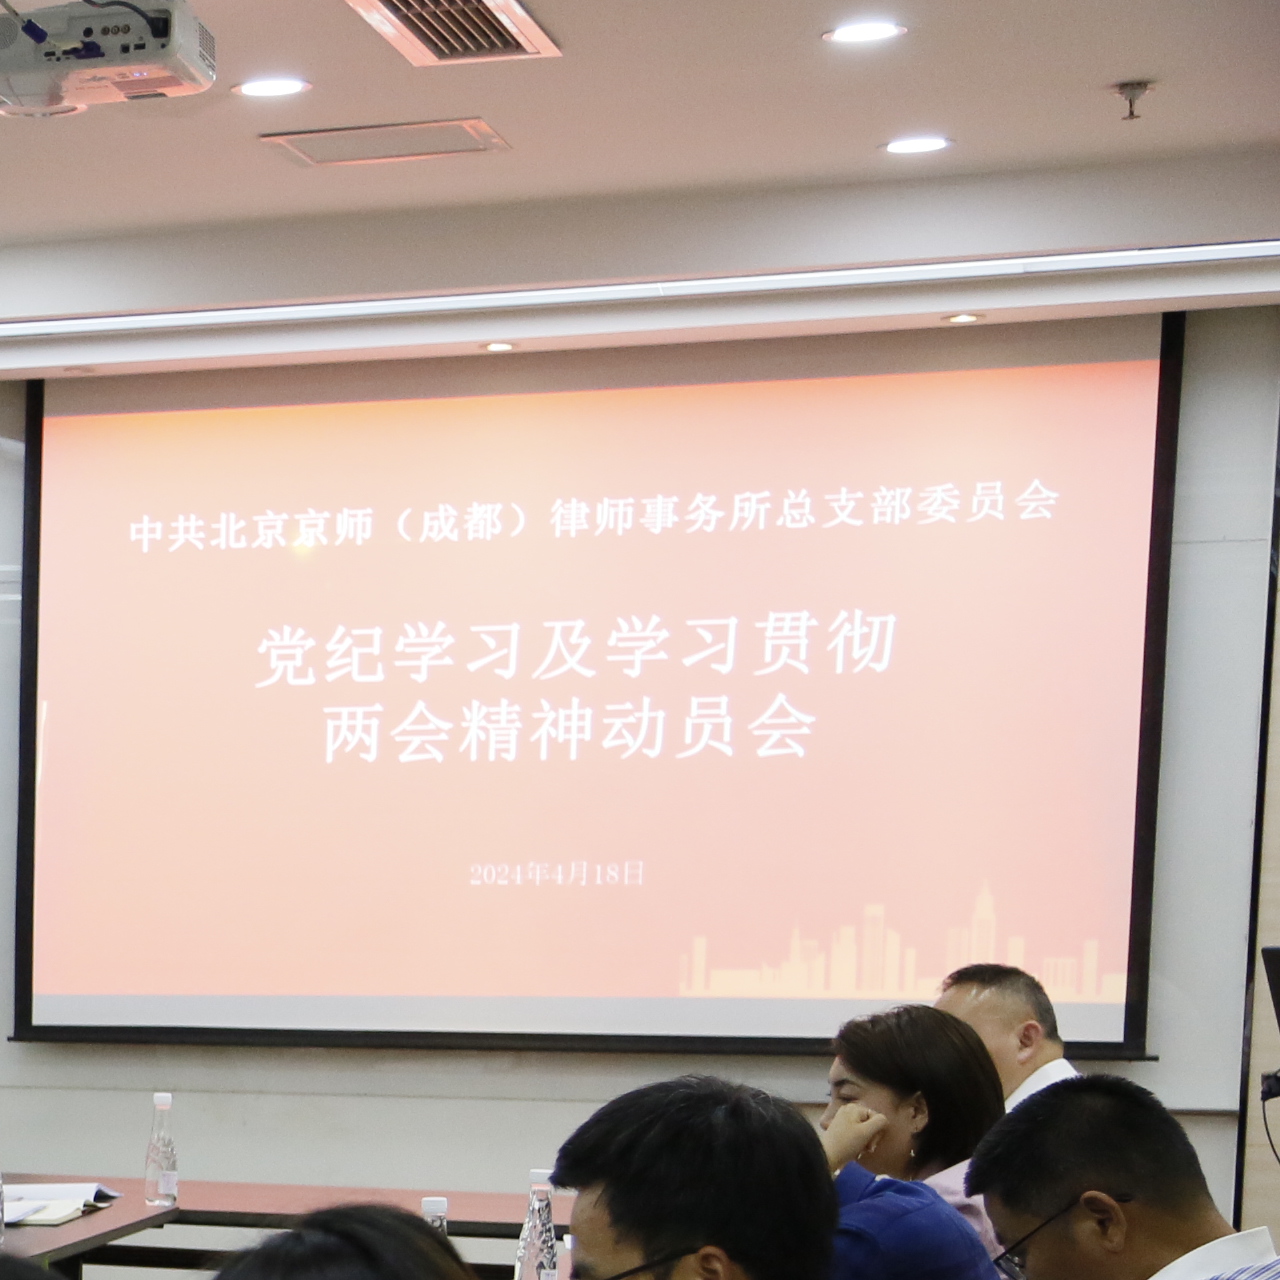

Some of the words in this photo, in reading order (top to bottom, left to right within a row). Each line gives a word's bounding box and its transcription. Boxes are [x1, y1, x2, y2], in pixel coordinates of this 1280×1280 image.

[128, 478, 1060, 554] 中共北京京师（成都）律师事务所总支部委员会
[254, 608, 897, 689] 党纪学习及学习贯彻
[321, 690, 818, 764] 两会精神动员会
[469, 860, 644, 887] 2024年4月18日
